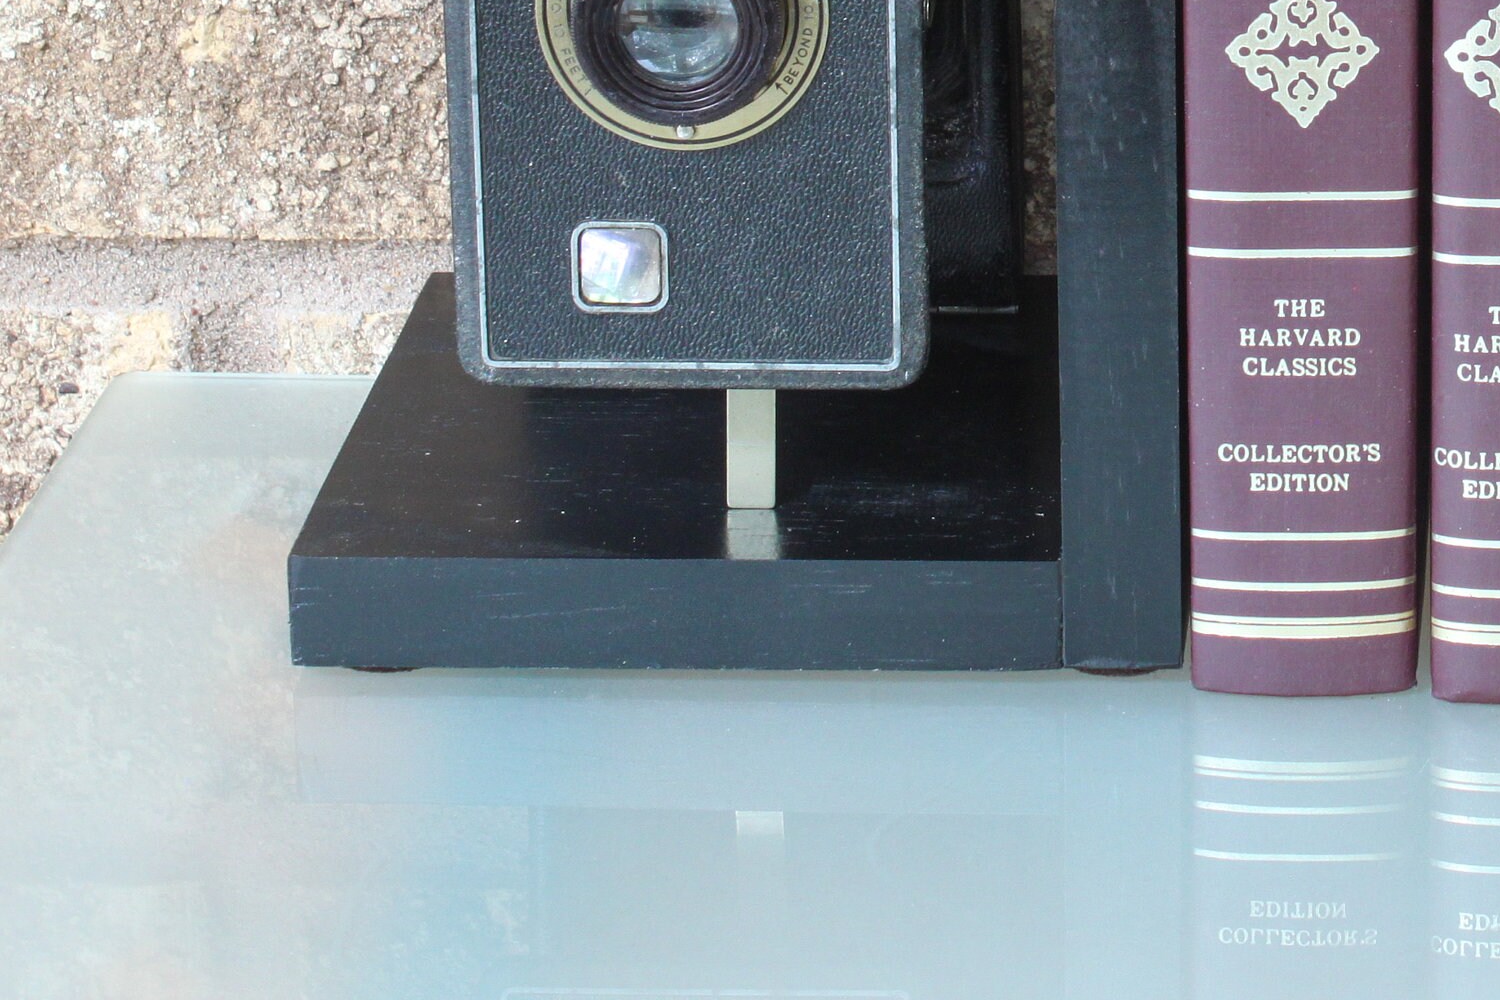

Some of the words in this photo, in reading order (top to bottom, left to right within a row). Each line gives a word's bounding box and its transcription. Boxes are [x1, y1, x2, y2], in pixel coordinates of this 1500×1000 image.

[560, 46, 588, 83] FEET
[782, 26, 814, 86] BEYOND
[1273, 298, 1326, 318] THE
[1239, 327, 1361, 347] HARVARD
[1242, 356, 1357, 377] CLASSICS
[1217, 442, 1381, 464] COLLECTOR'S
[1249, 472, 1350, 493] EDITION
